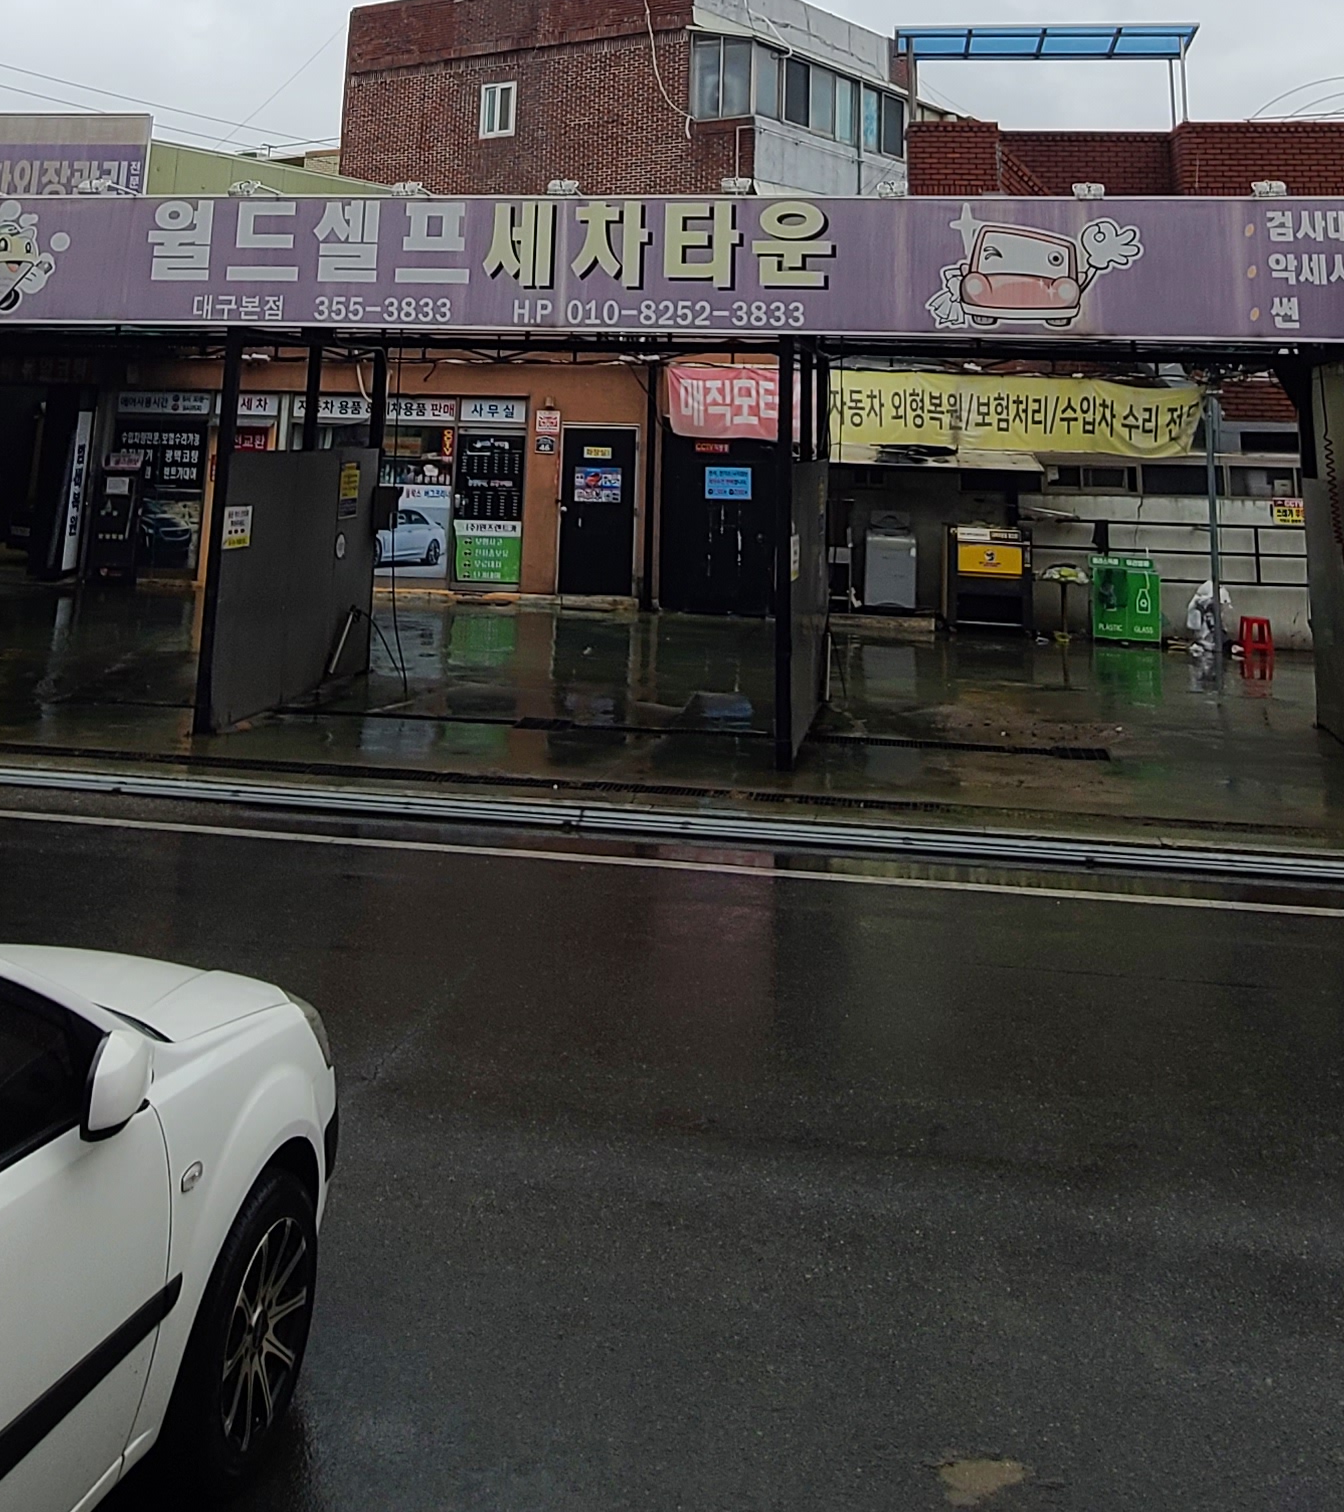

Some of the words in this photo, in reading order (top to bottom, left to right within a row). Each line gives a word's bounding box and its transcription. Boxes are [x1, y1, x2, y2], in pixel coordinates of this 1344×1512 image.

[192, 295, 285, 321] 대구본점
[313, 296, 452, 323] 355-3833
[513, 299, 553, 325] H.P
[566, 299, 805, 327] 010-8252-3833
[338, 399, 362, 415] 용품
[430, 402, 455, 417] 판매
[829, 389, 885, 428] 자동차
[1120, 402, 1159, 442] 수리
[1098, 622, 1123, 632] PLASTIC
[1133, 624, 1154, 635] GLASS
